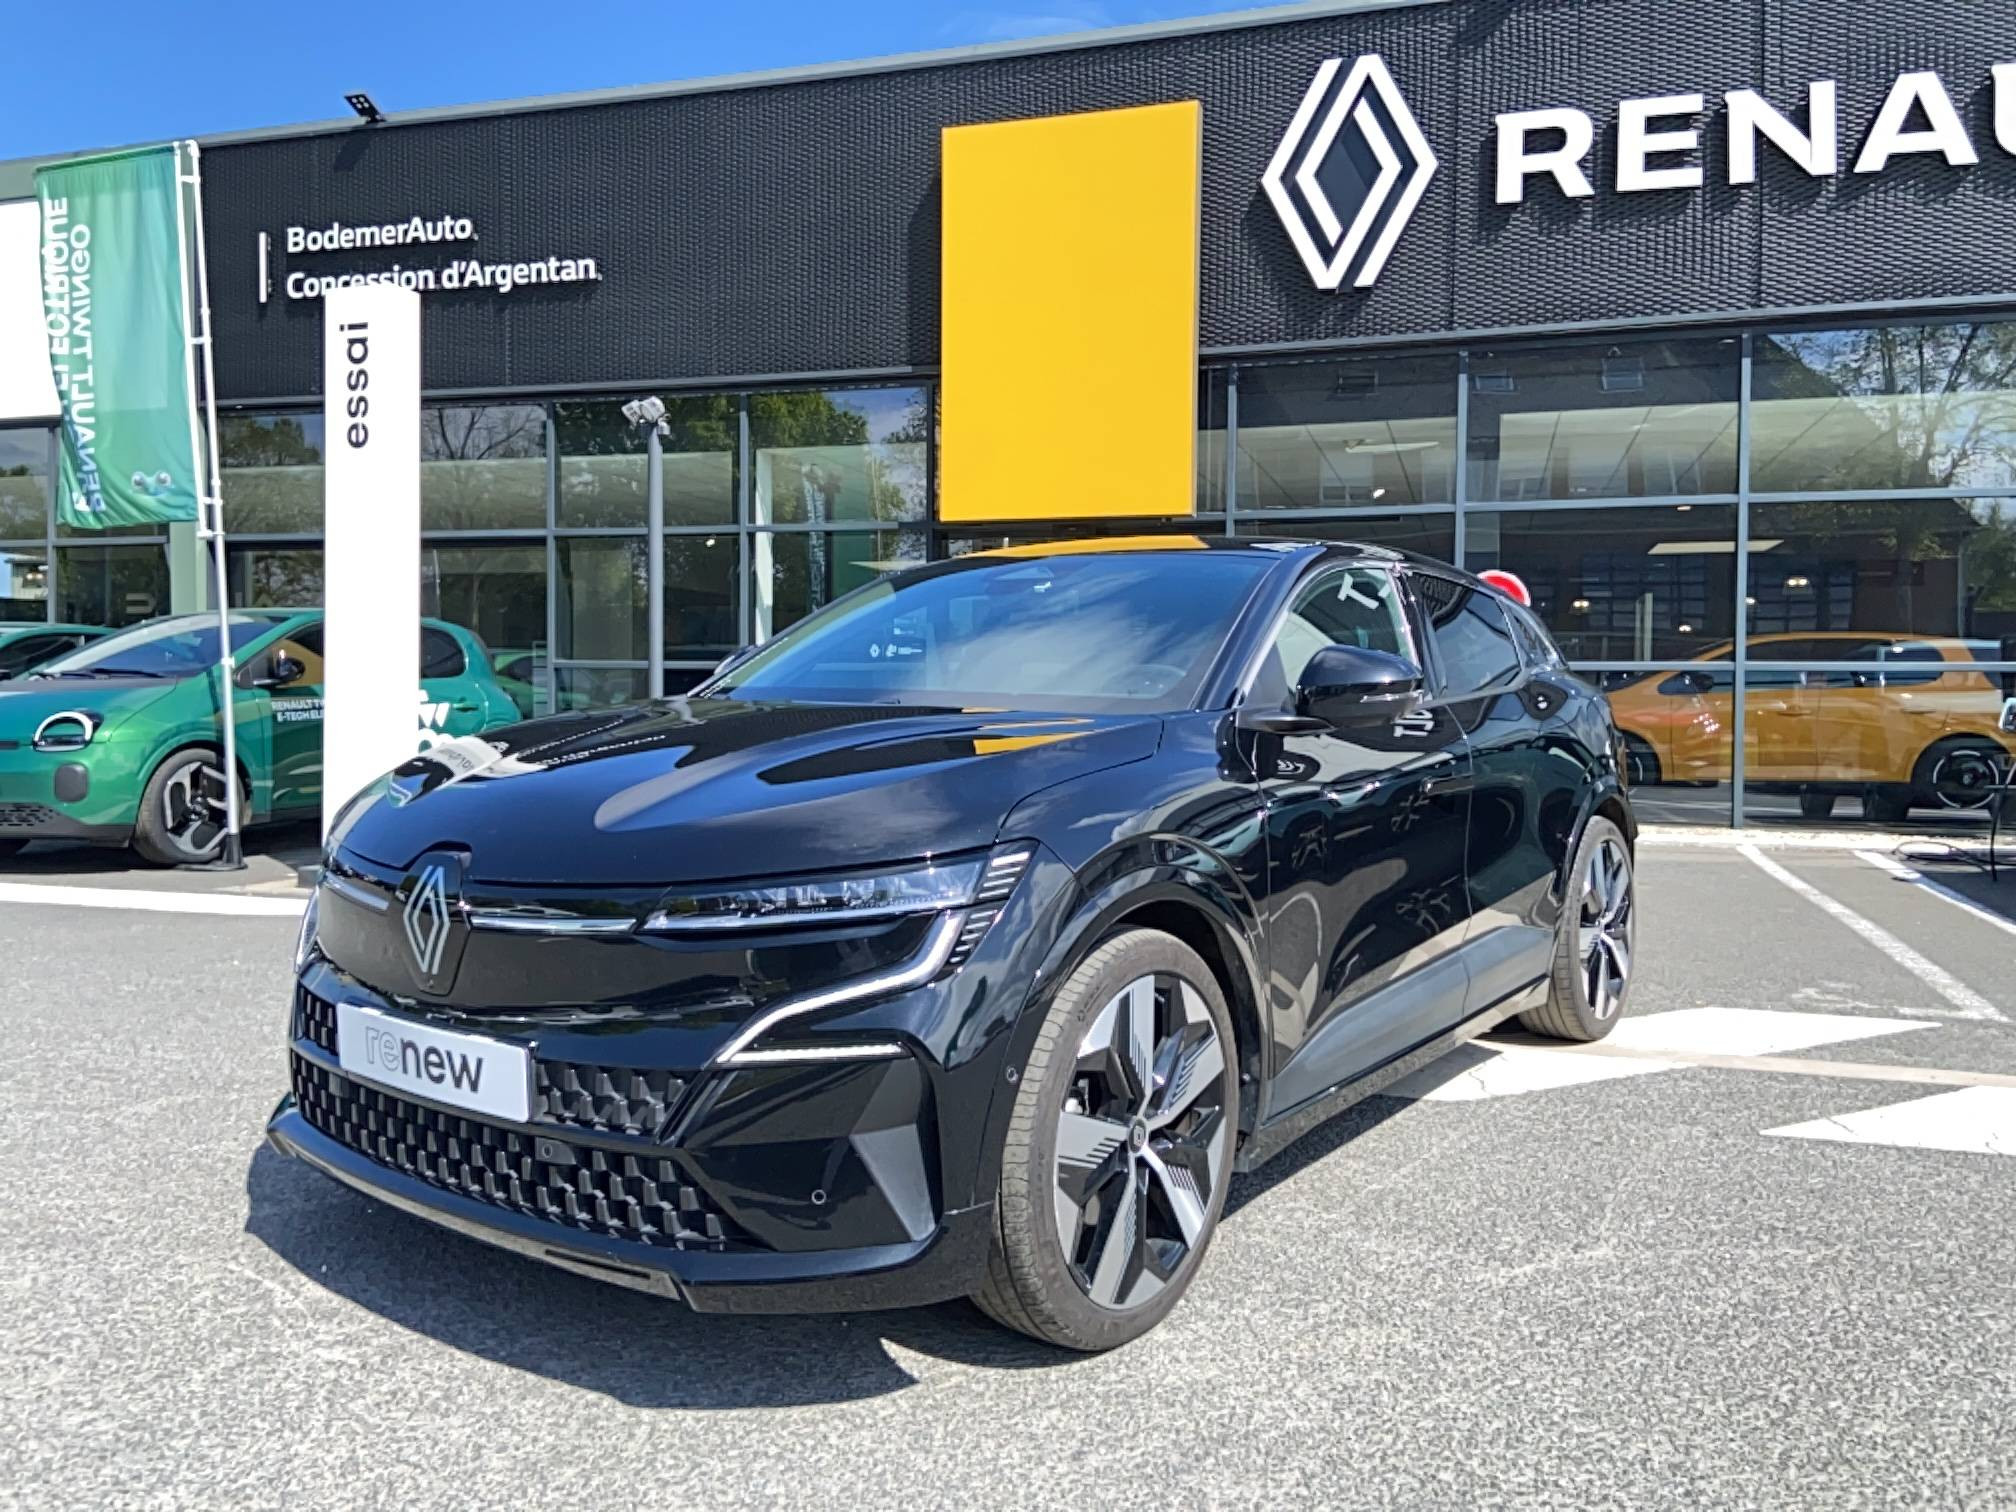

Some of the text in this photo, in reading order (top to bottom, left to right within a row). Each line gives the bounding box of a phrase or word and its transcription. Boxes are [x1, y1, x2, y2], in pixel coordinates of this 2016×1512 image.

[1494, 63, 2016, 204] RENA
[340, 321, 368, 449] essai
[364, 1026, 484, 1093] renew
